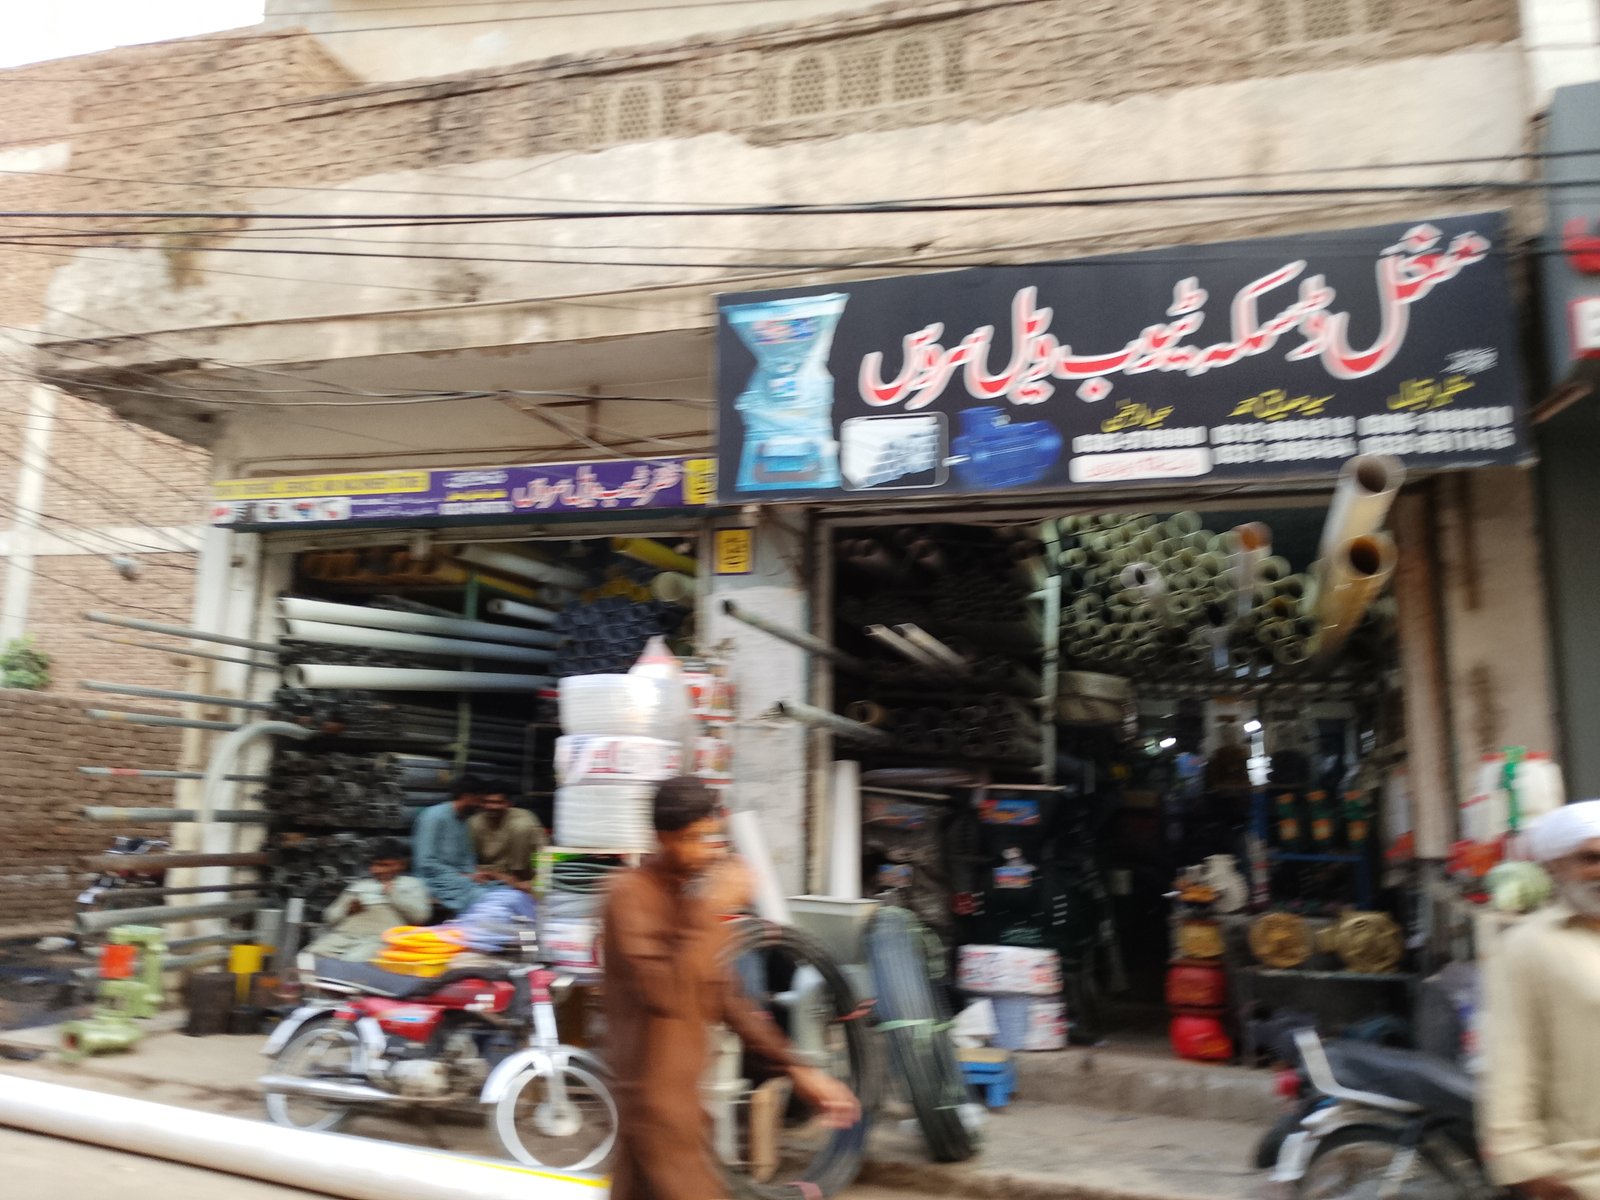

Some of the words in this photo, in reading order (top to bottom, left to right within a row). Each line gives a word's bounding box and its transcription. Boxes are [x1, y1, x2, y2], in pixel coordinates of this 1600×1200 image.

[858, 322, 994, 410] سروس
[964, 286, 1062, 405] ویل
[1052, 276, 1208, 402] ٹیوب
